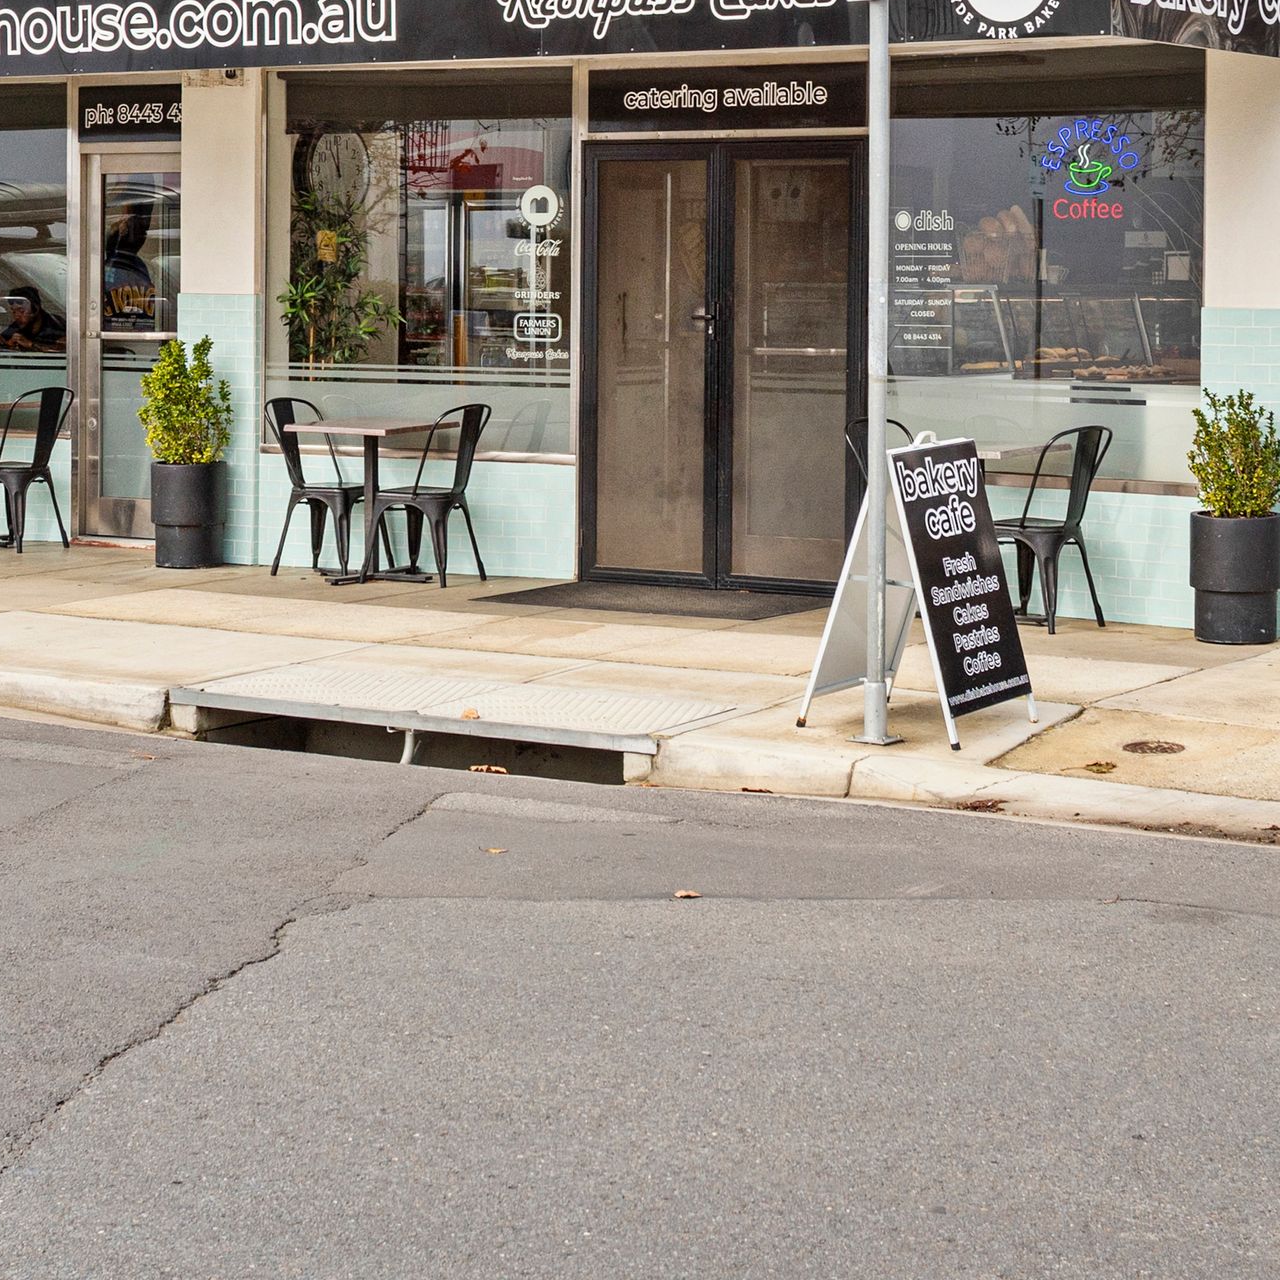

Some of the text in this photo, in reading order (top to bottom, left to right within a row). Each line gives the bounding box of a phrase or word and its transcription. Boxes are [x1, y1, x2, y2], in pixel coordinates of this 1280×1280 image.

[977, 21, 1018, 40] PARK
[624, 81, 828, 113] catering available
[85, 104, 114, 128] ph:
[117, 104, 164, 124] 8443
[1041, 118, 1139, 171] ESPRESSO
[1053, 197, 1124, 219] Coffee
[914, 210, 954, 231] dish
[895, 243, 953, 251] OPENING HOURS
[514, 291, 561, 299] GRINDERS
[519, 319, 556, 328] FARMERS
[524, 327, 551, 336] UNION
[896, 456, 977, 502] bakery
[925, 494, 976, 540] cafe
[942, 551, 977, 577] Fresh
[931, 574, 1000, 606] Sandwiches
[952, 602, 989, 626] Cakes
[952, 624, 1000, 653] Pastries
[963, 650, 1002, 676] Coffee
